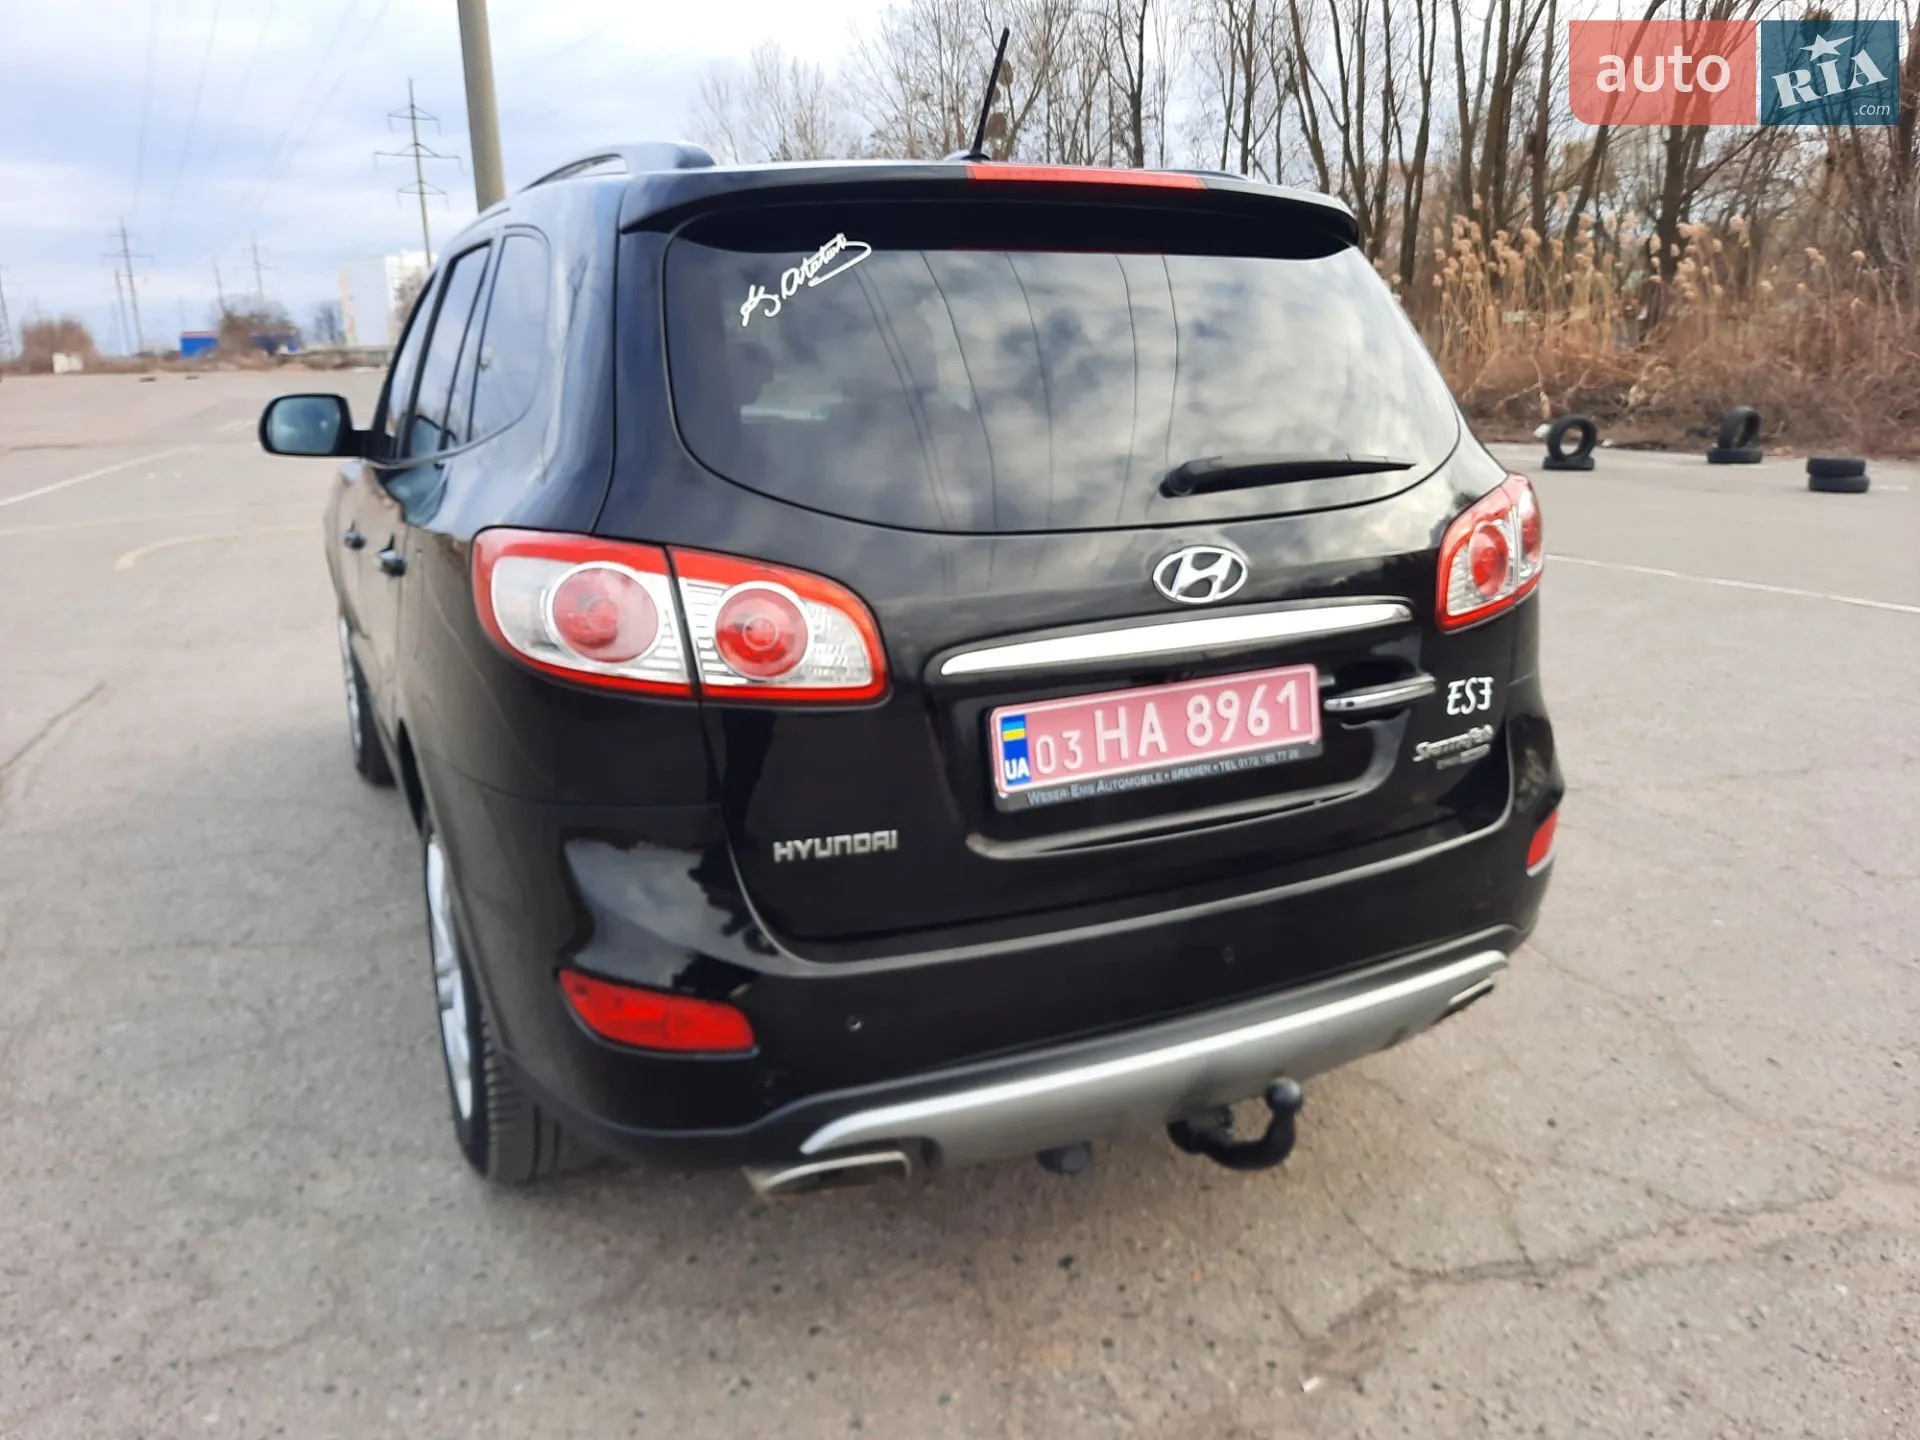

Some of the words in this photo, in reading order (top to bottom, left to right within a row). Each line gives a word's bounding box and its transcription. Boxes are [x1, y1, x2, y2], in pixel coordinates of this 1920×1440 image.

[1035, 729, 1083, 775] 03
[1095, 702, 1168, 763] HA
[1186, 679, 1300, 747] 8961
[1004, 758, 1031, 781] UA
[772, 829, 898, 863] HYUNDAI
